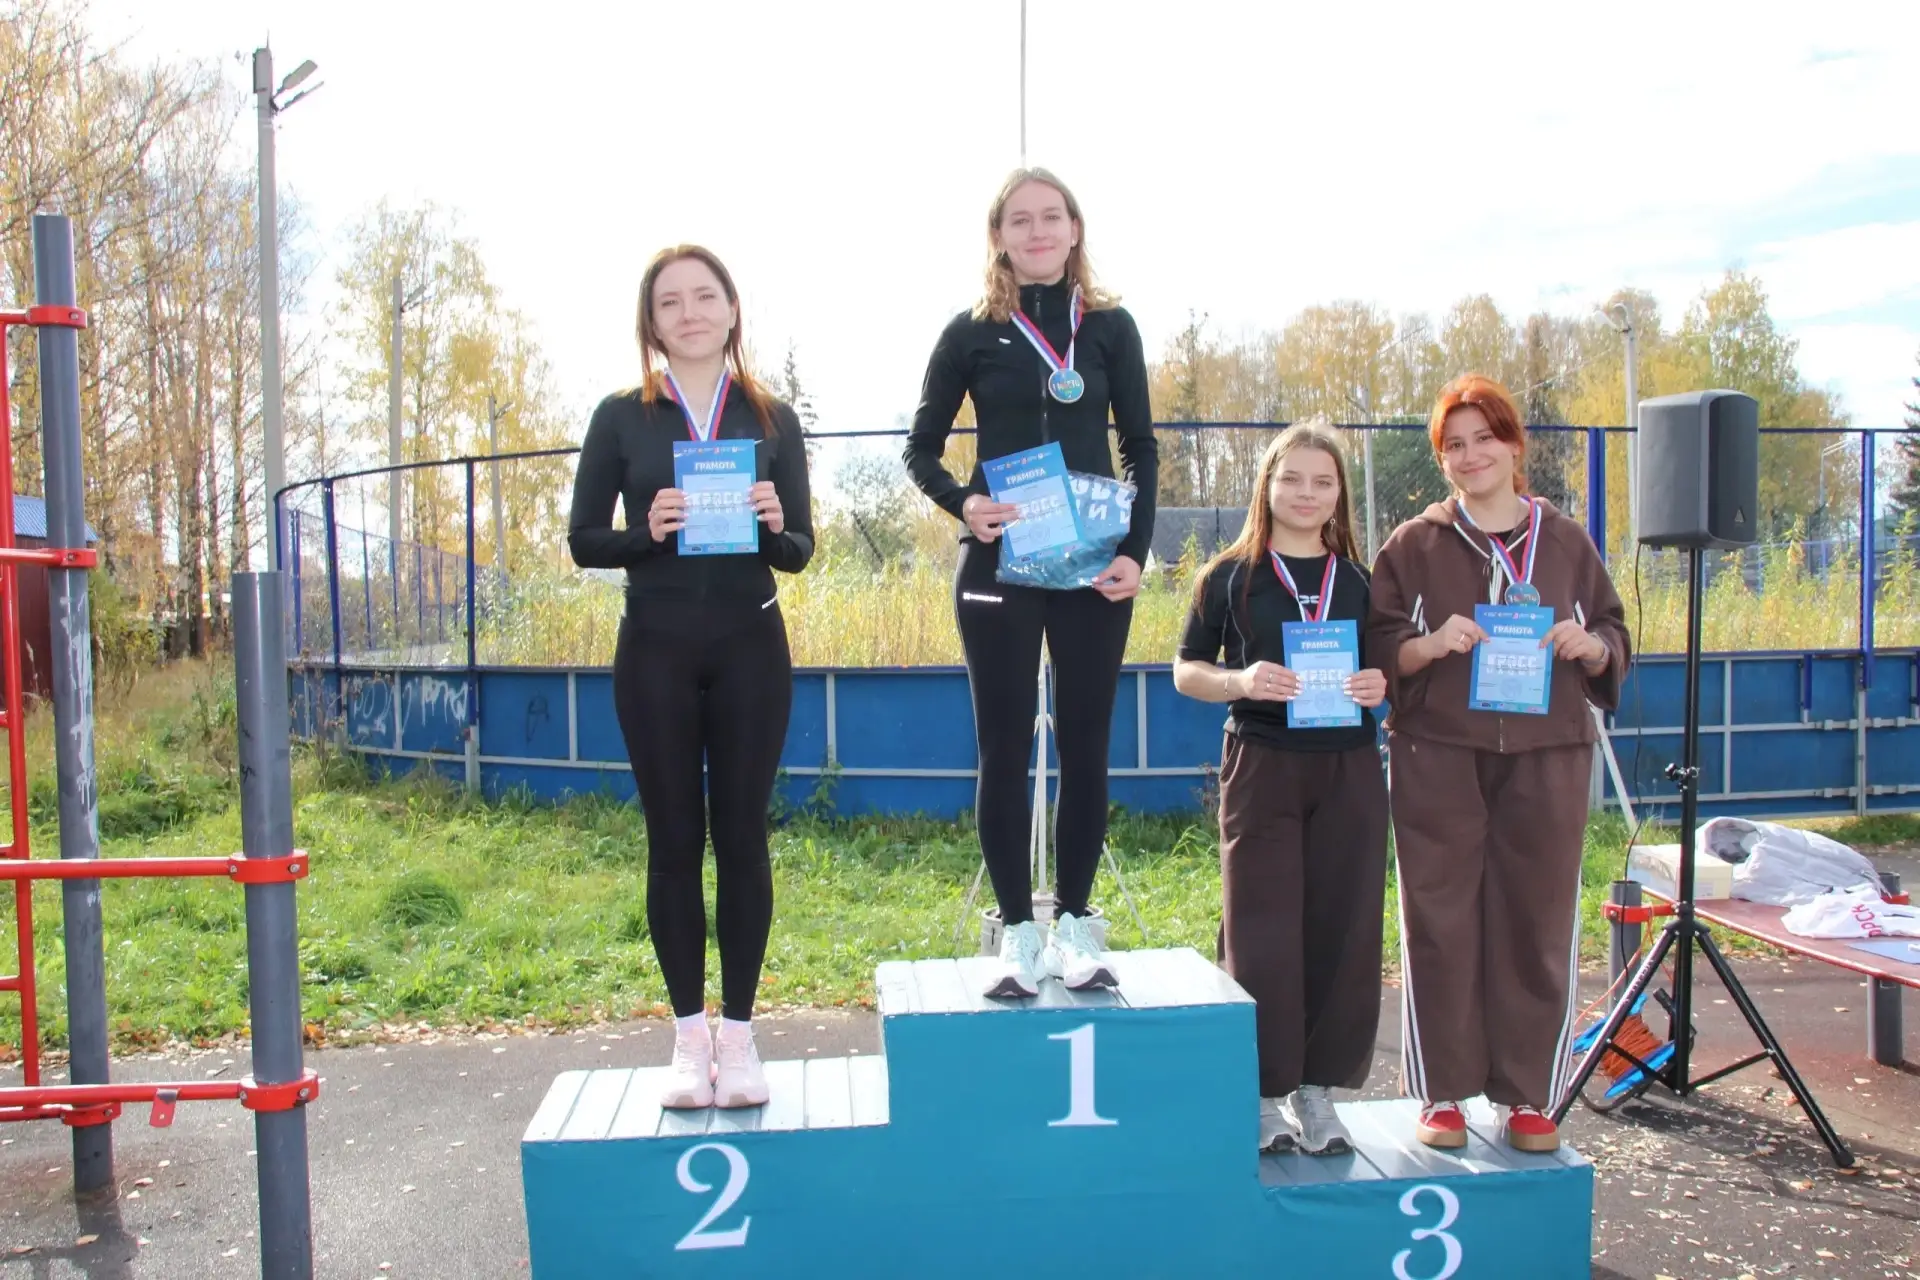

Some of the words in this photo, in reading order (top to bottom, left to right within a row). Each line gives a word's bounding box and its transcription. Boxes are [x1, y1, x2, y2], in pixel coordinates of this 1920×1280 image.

[695, 461, 736, 471] ГРАМОТА
[1005, 468, 1046, 485] ГРАМОТА
[1493, 625, 1533, 635] ГРАМОТА
[1301, 641, 1339, 649] ГРАМОТА
[1048, 1023, 1117, 1127] 1
[675, 1142, 752, 1250] 2
[1392, 1184, 1462, 1280] 3
